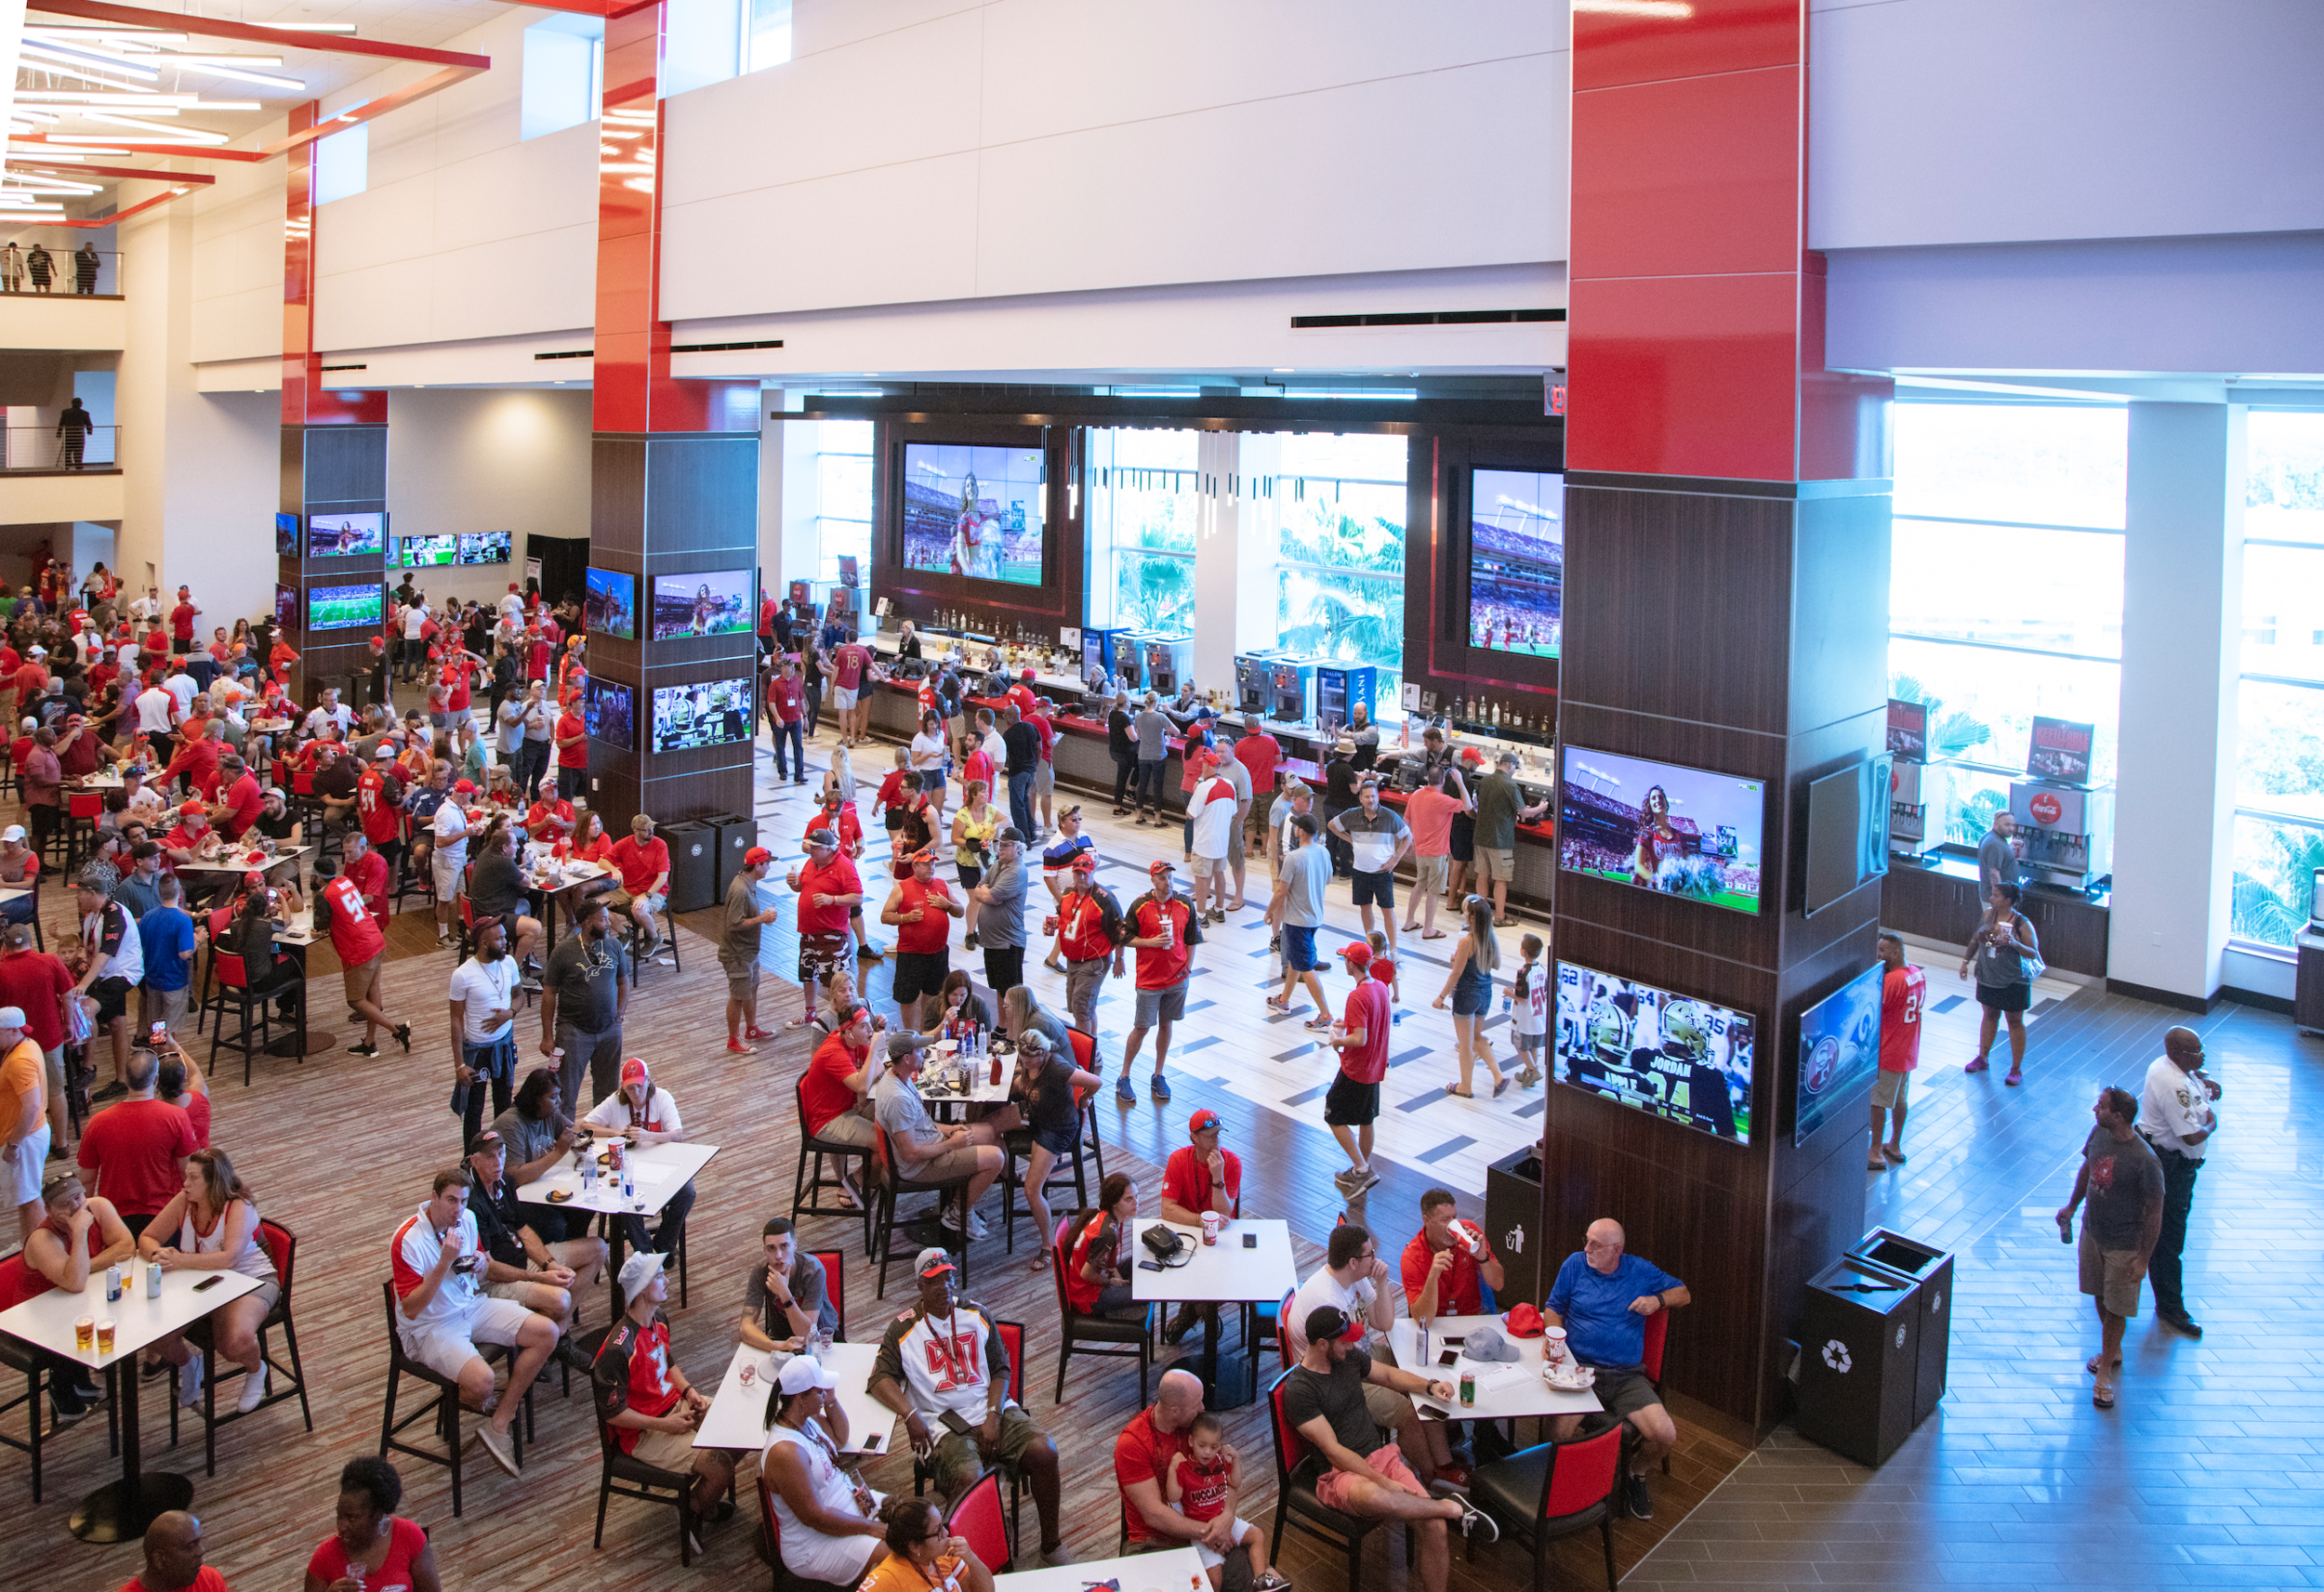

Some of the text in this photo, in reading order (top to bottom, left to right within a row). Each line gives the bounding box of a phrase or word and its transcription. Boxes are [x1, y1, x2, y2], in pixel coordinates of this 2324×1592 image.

[847, 655, 860, 669] 18
[1357, 674, 1366, 703] SANI
[361, 788, 376, 812] 54
[1562, 967, 1578, 986] 62
[1638, 989, 1656, 1007] 64
[1650, 1055, 1692, 1078] JORDAN
[924, 1330, 984, 1394] 90
